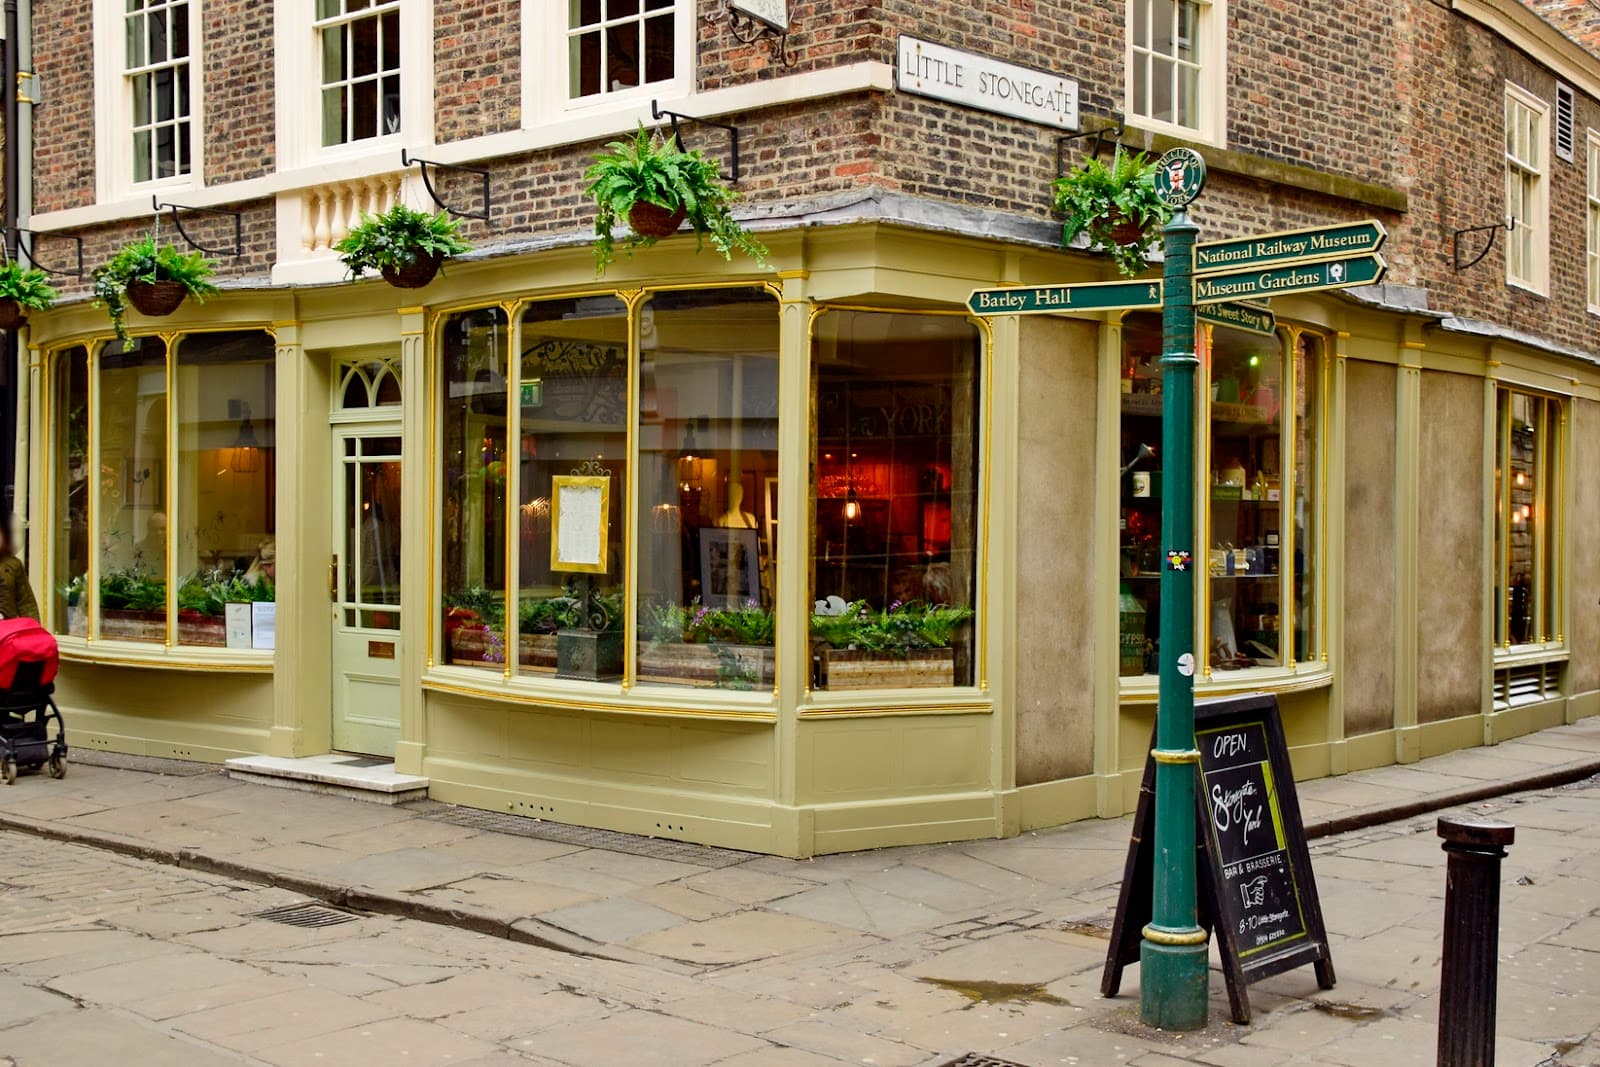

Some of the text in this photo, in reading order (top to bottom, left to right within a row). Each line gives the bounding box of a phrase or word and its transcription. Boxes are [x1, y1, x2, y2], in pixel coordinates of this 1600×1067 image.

[905, 51, 1072, 115] LITTLE STONEGATE
[1198, 233, 1371, 264] National Railway Museum
[1197, 270, 1320, 298] Museum Gardens
[979, 288, 1072, 310] Barley Hall
[1197, 303, 1260, 329] ork's Sweet Story
[1212, 780, 1257, 832] Stonegate
[1243, 805, 1262, 846] Yard
[1224, 866, 1238, 880] BAR
[1246, 854, 1282, 873] BRASSERIE
[1239, 914, 1258, 934] 8-10
